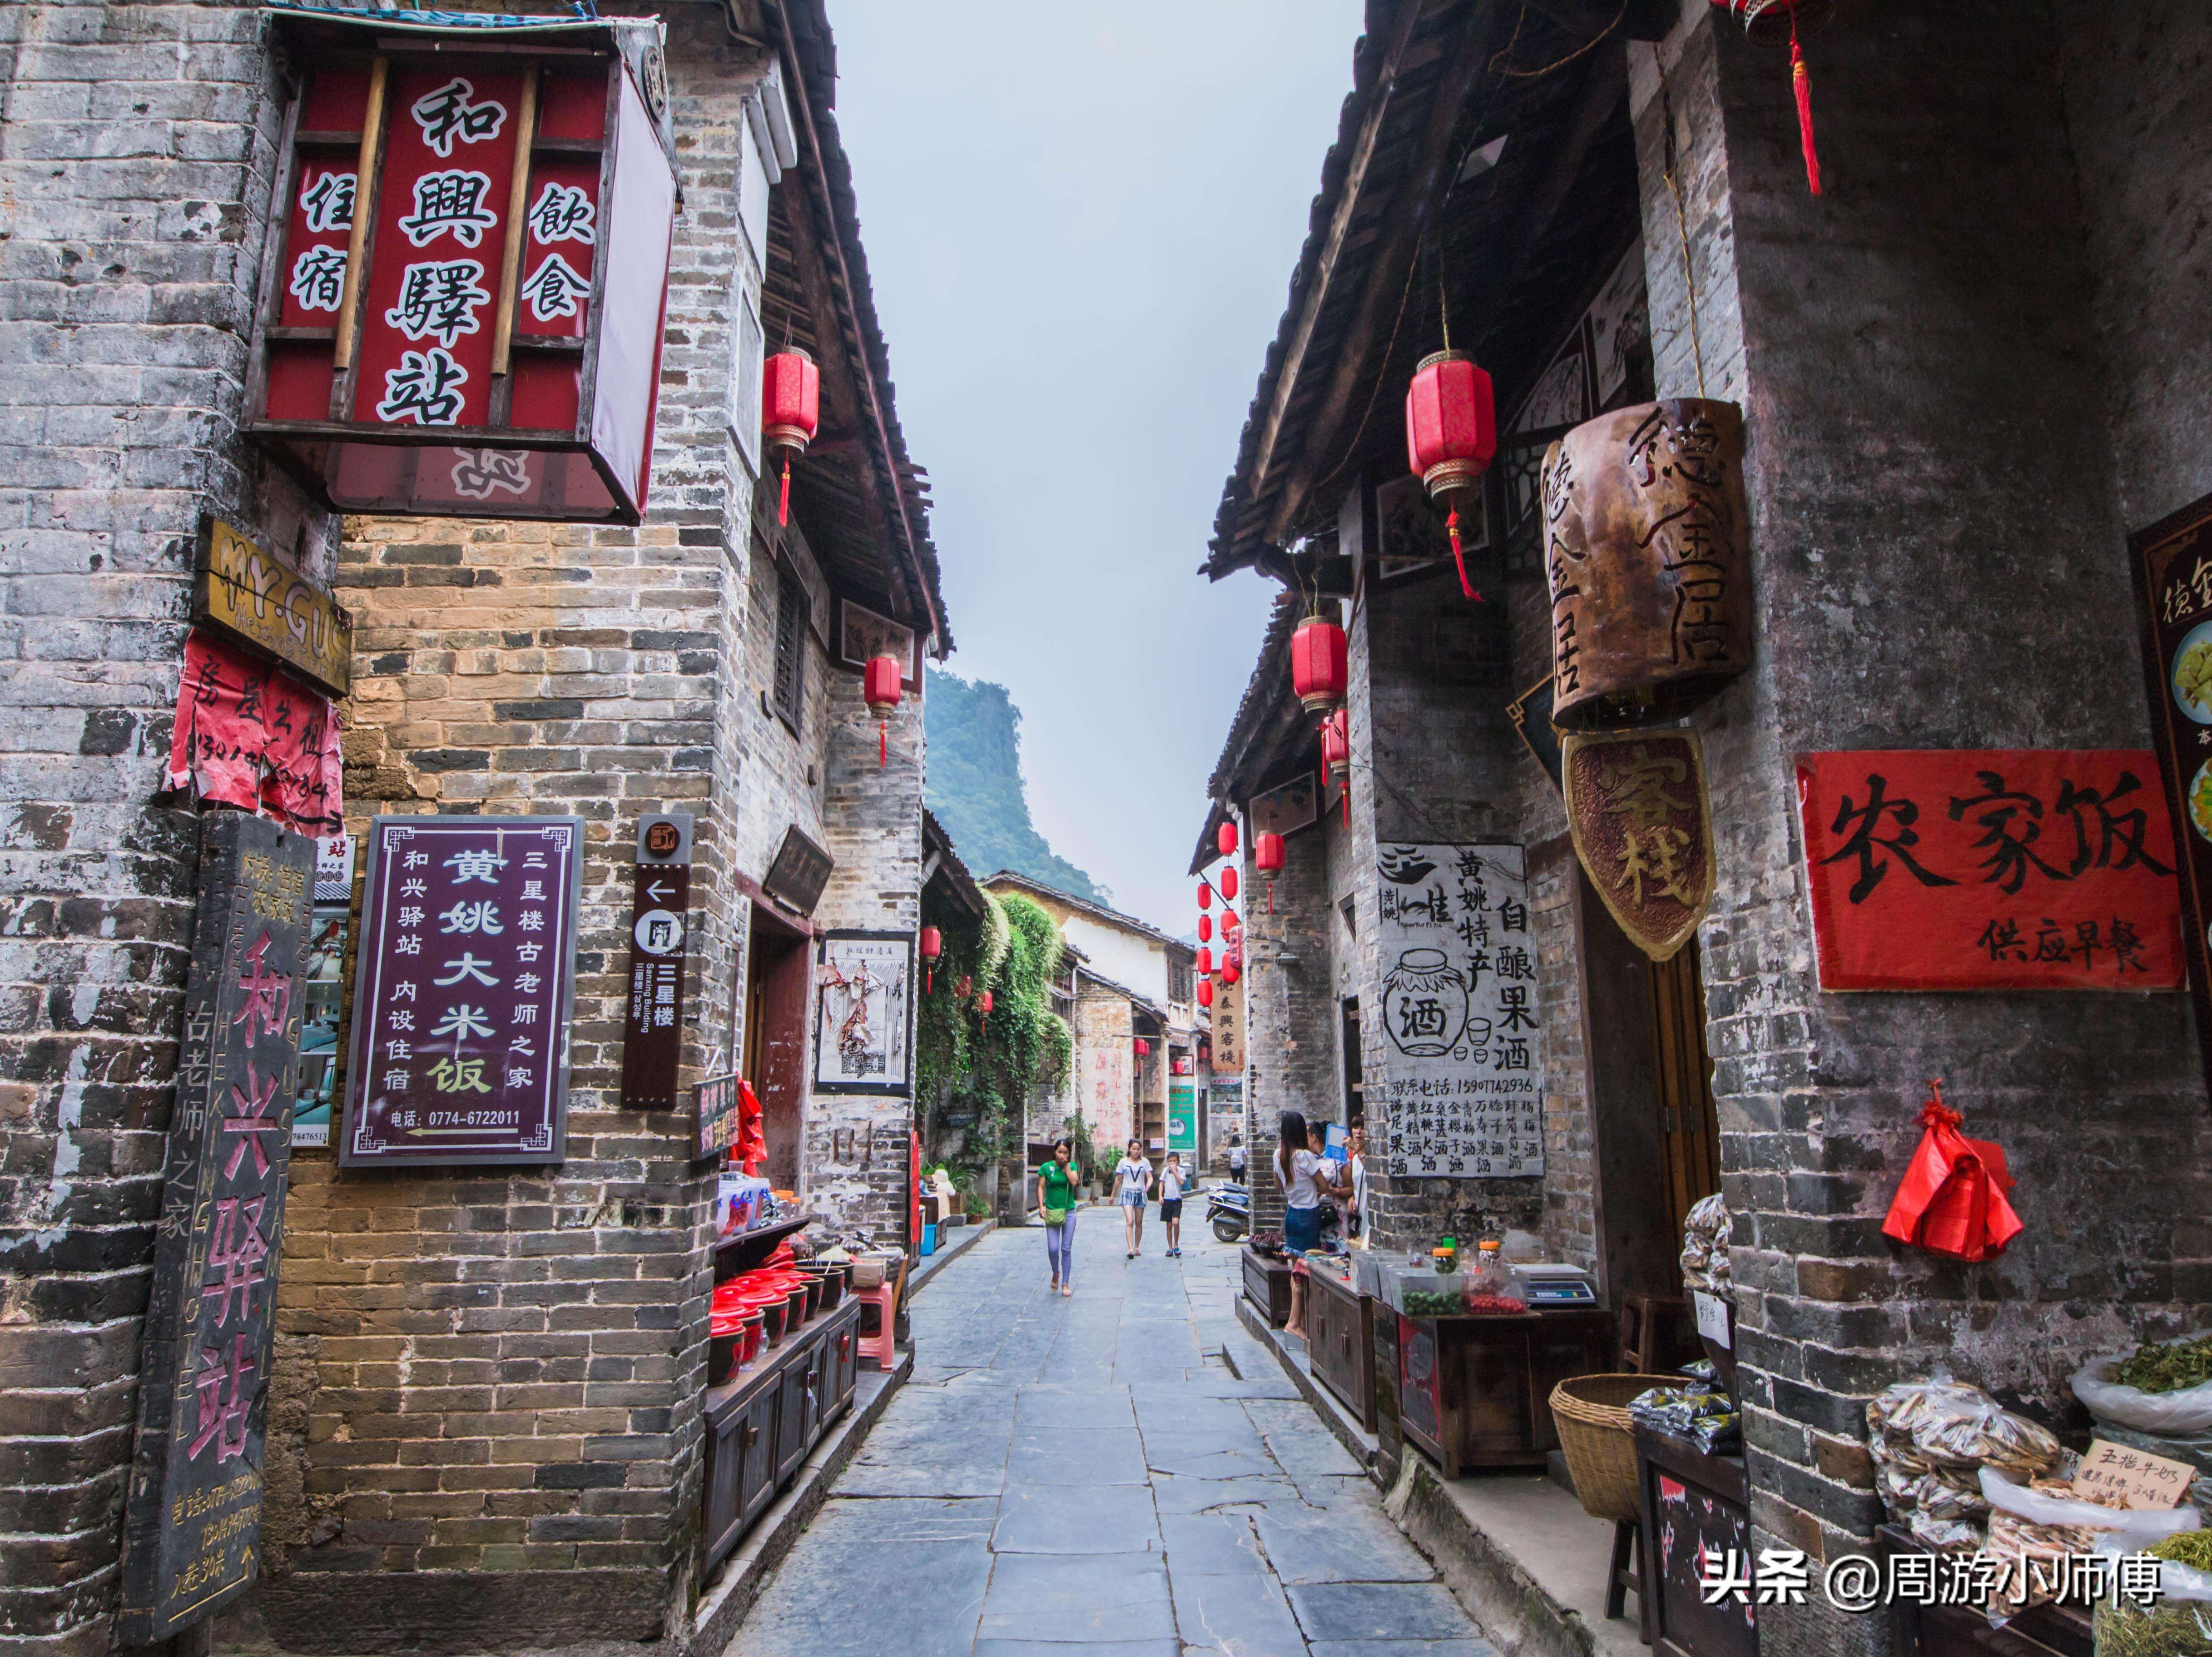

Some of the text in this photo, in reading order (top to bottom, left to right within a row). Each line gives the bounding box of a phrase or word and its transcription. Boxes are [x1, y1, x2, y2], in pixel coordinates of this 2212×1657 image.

[290, 172, 357, 311] 住宿
[377, 78, 507, 425] 和興驛站
[522, 183, 595, 322] 飲食
[193, 654, 324, 758] 房屋出租
[1819, 771, 2177, 904] 农家饭
[1383, 888, 1399, 920] 黄姚
[1455, 851, 1493, 994] 黄姚特产
[1977, 917, 2148, 973] 供应早餐
[383, 850, 429, 1090] 和兴驿站 内设住宿
[426, 849, 508, 1093] 黄姚大米饭
[505, 852, 548, 1089] 三星楼古老师之家
[641, 963, 654, 1033] Sanxing Building
[654, 965, 676, 1026] 三星楼
[1494, 896, 1540, 1072] 自酿果酒
[1399, 997, 1448, 1038] 酒
[1389, 1099, 1408, 1174] 诺尼果酒
[1462, 1100, 1476, 1156] 青梅酒
[1474, 1100, 1491, 1173] 万寿果酒
[1521, 1100, 1537, 1157] 杨梅酒
[1126, 1165, 1143, 1183] V
